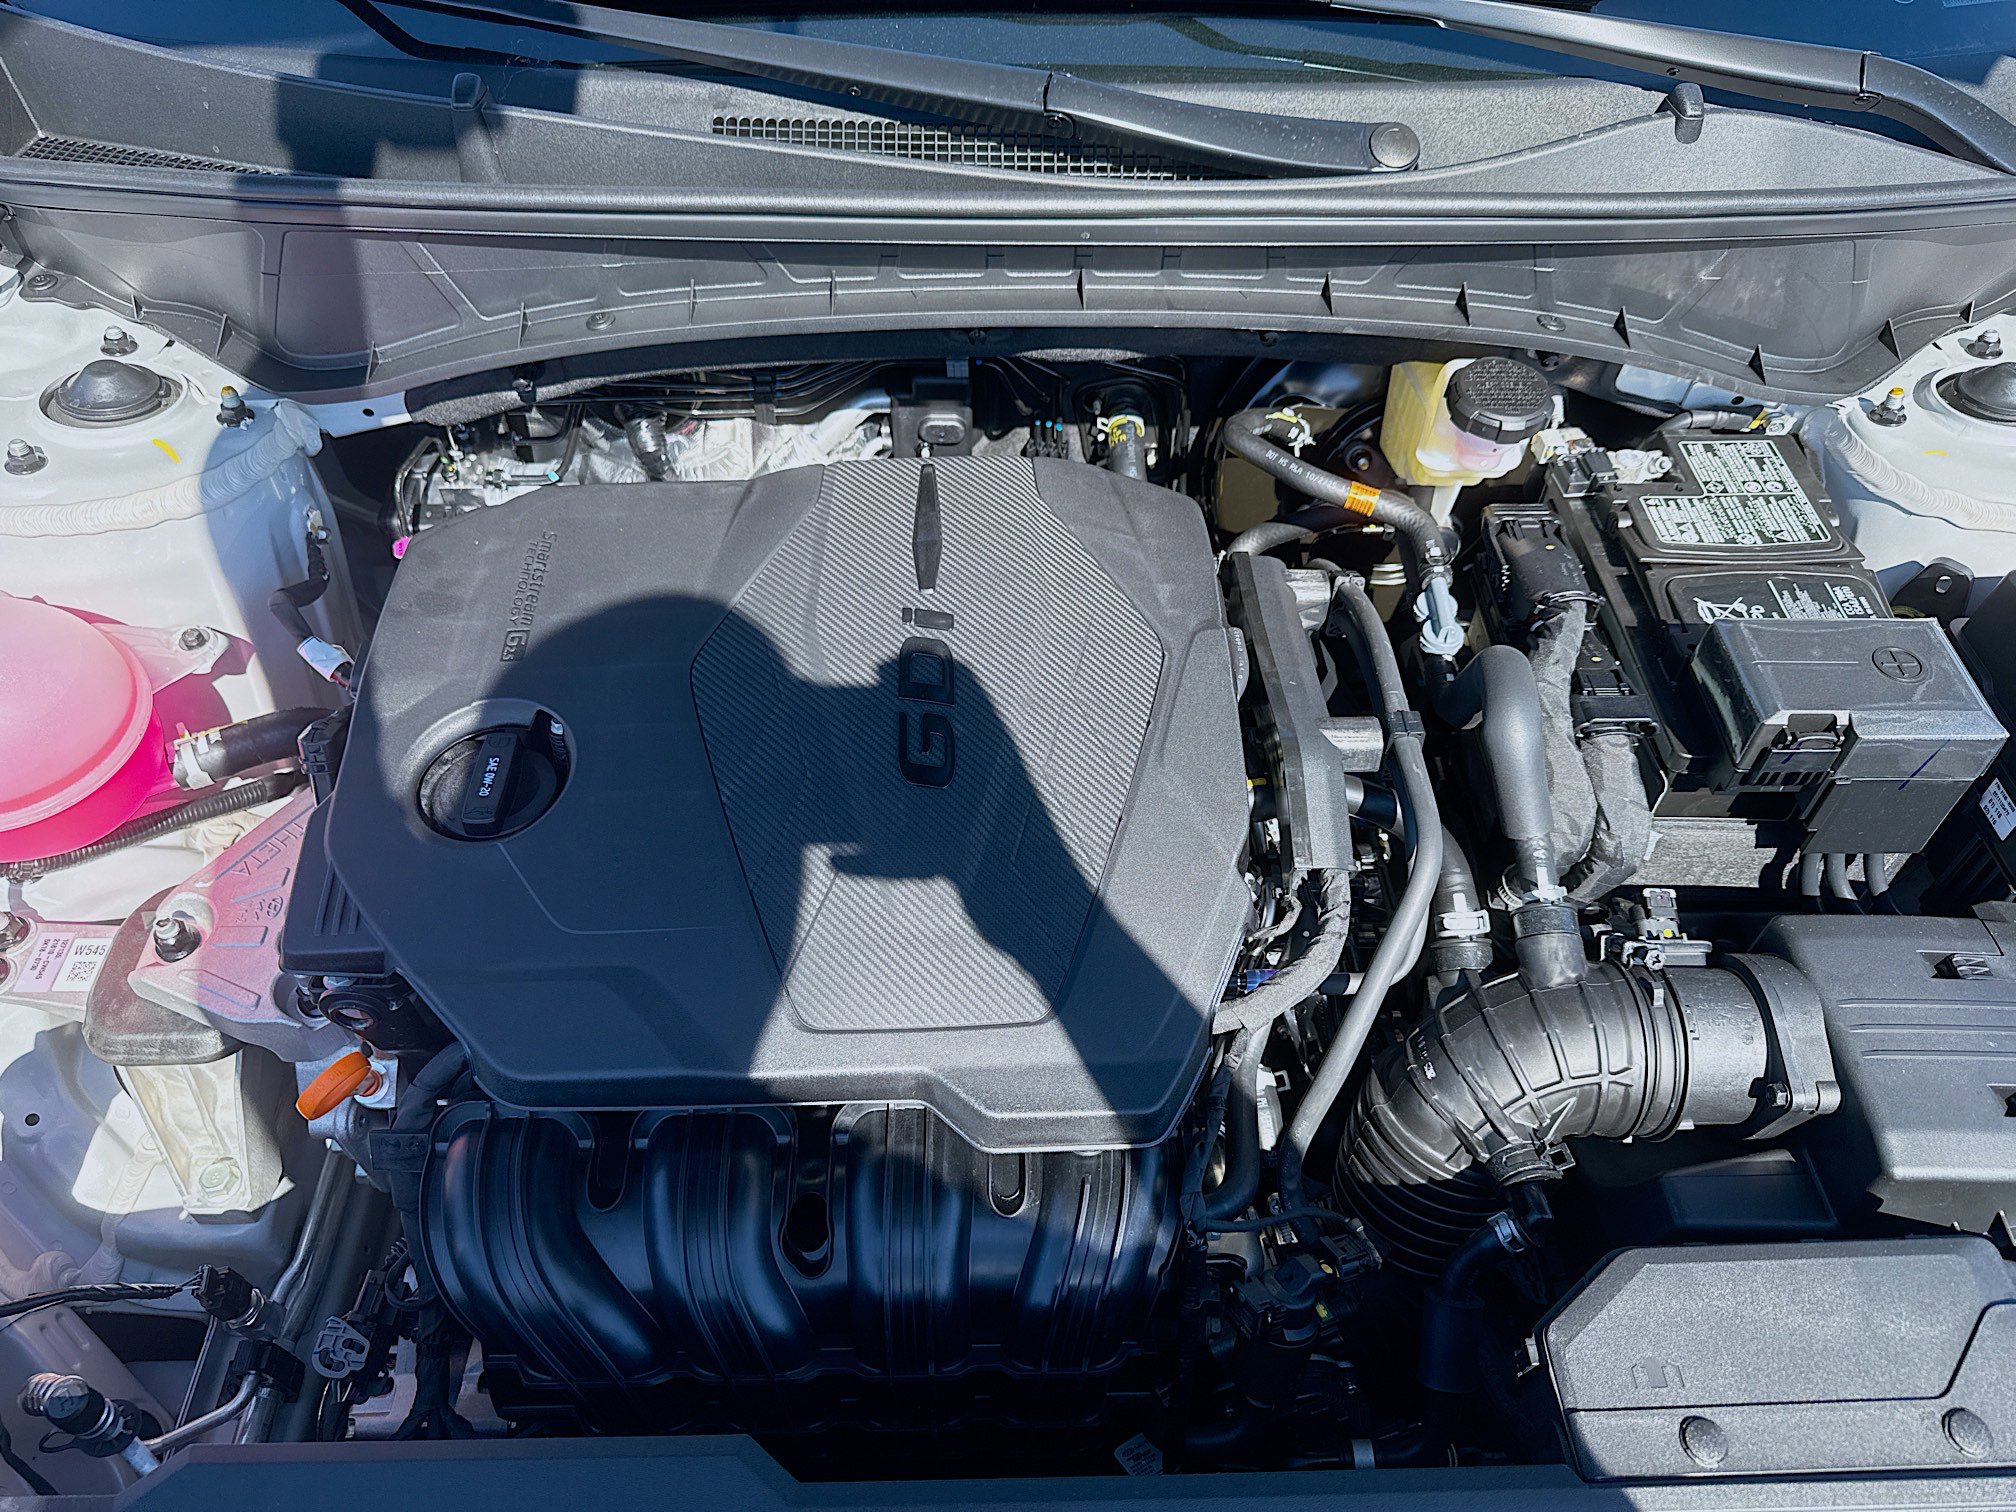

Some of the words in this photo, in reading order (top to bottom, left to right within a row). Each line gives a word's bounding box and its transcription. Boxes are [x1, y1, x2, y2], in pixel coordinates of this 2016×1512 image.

[1265, 448, 1277, 462] DOT
[509, 541, 540, 626] TECHNOLOGY
[520, 531, 558, 626] Smartstream
[898, 606, 957, 789] GDi
[486, 757, 500, 772] SAE
[478, 772, 496, 797] 0W-20
[231, 822, 304, 876] THETA
[74, 944, 108, 956] W545
